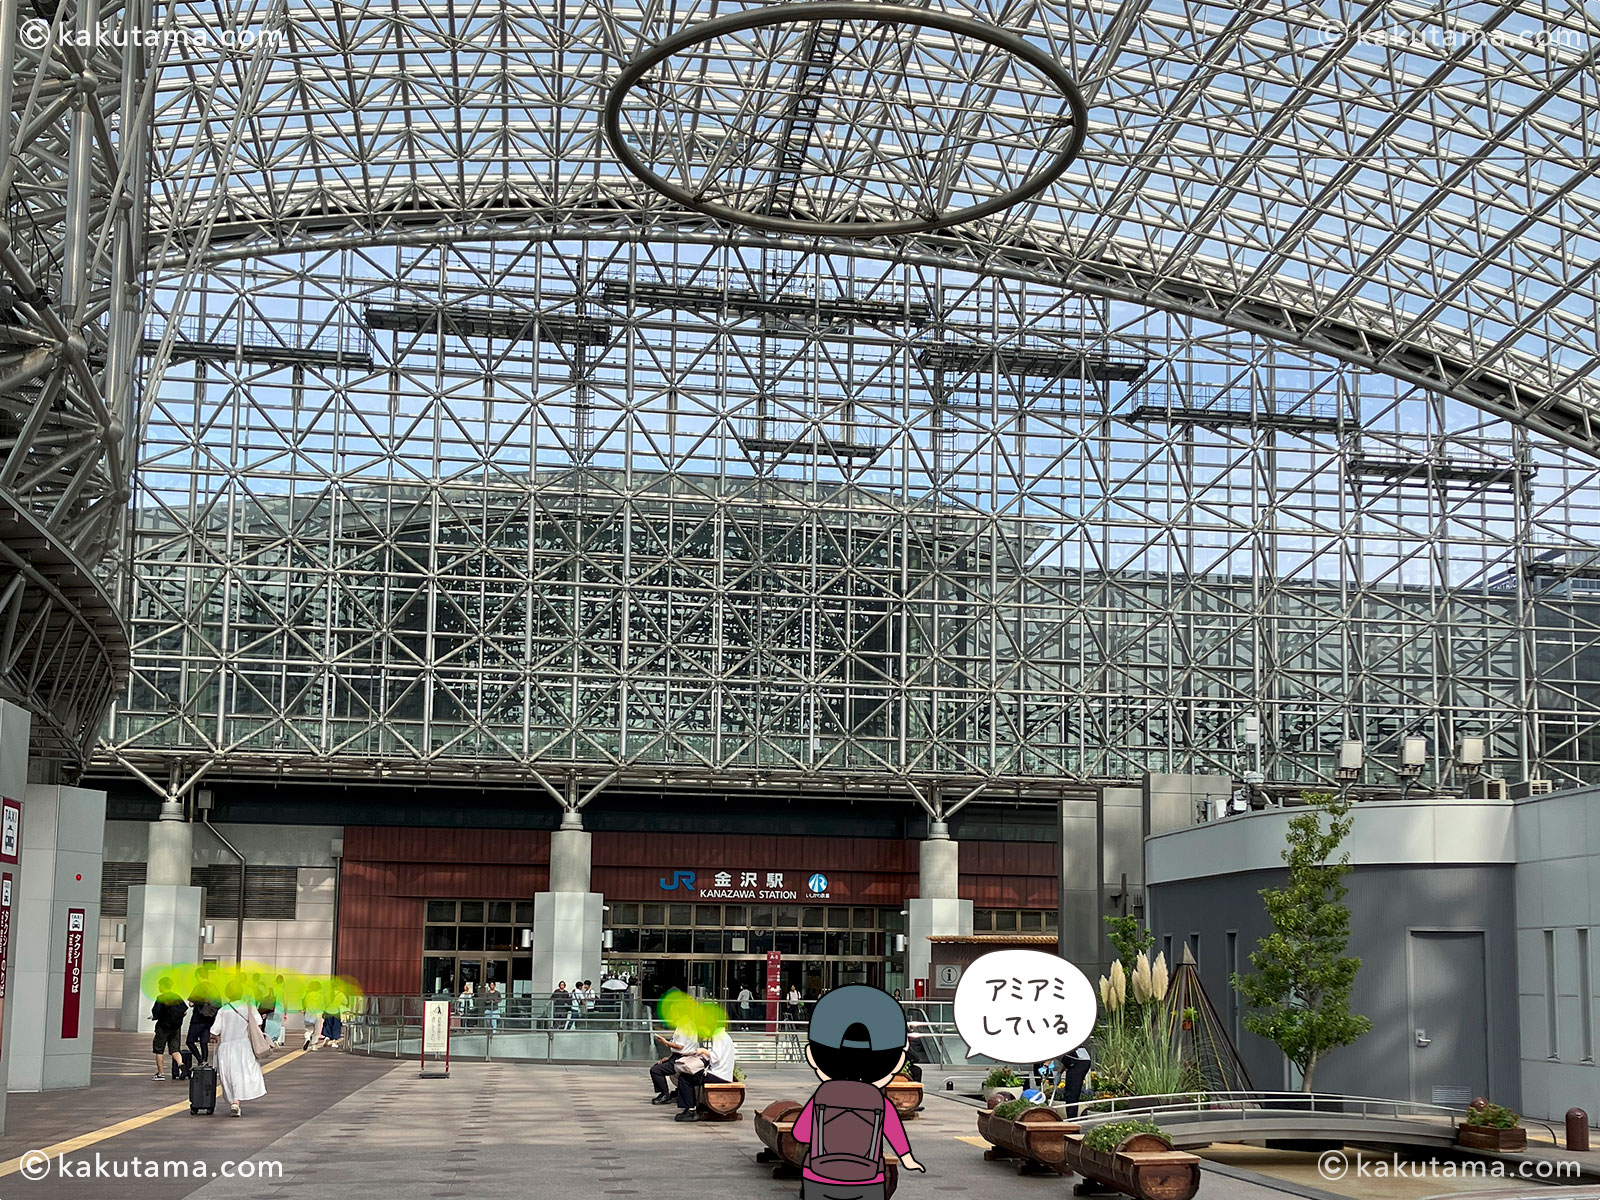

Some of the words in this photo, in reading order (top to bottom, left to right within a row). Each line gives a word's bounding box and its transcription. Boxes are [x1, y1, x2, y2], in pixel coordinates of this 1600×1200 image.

[5, 808, 17, 824] TAXI
[660, 871, 695, 891] JR
[714, 871, 783, 888] 金沢駅
[700, 889, 755, 899] KANAZAWA
[759, 890, 797, 899] STATION
[72, 934, 81, 993] タクシーのりば
